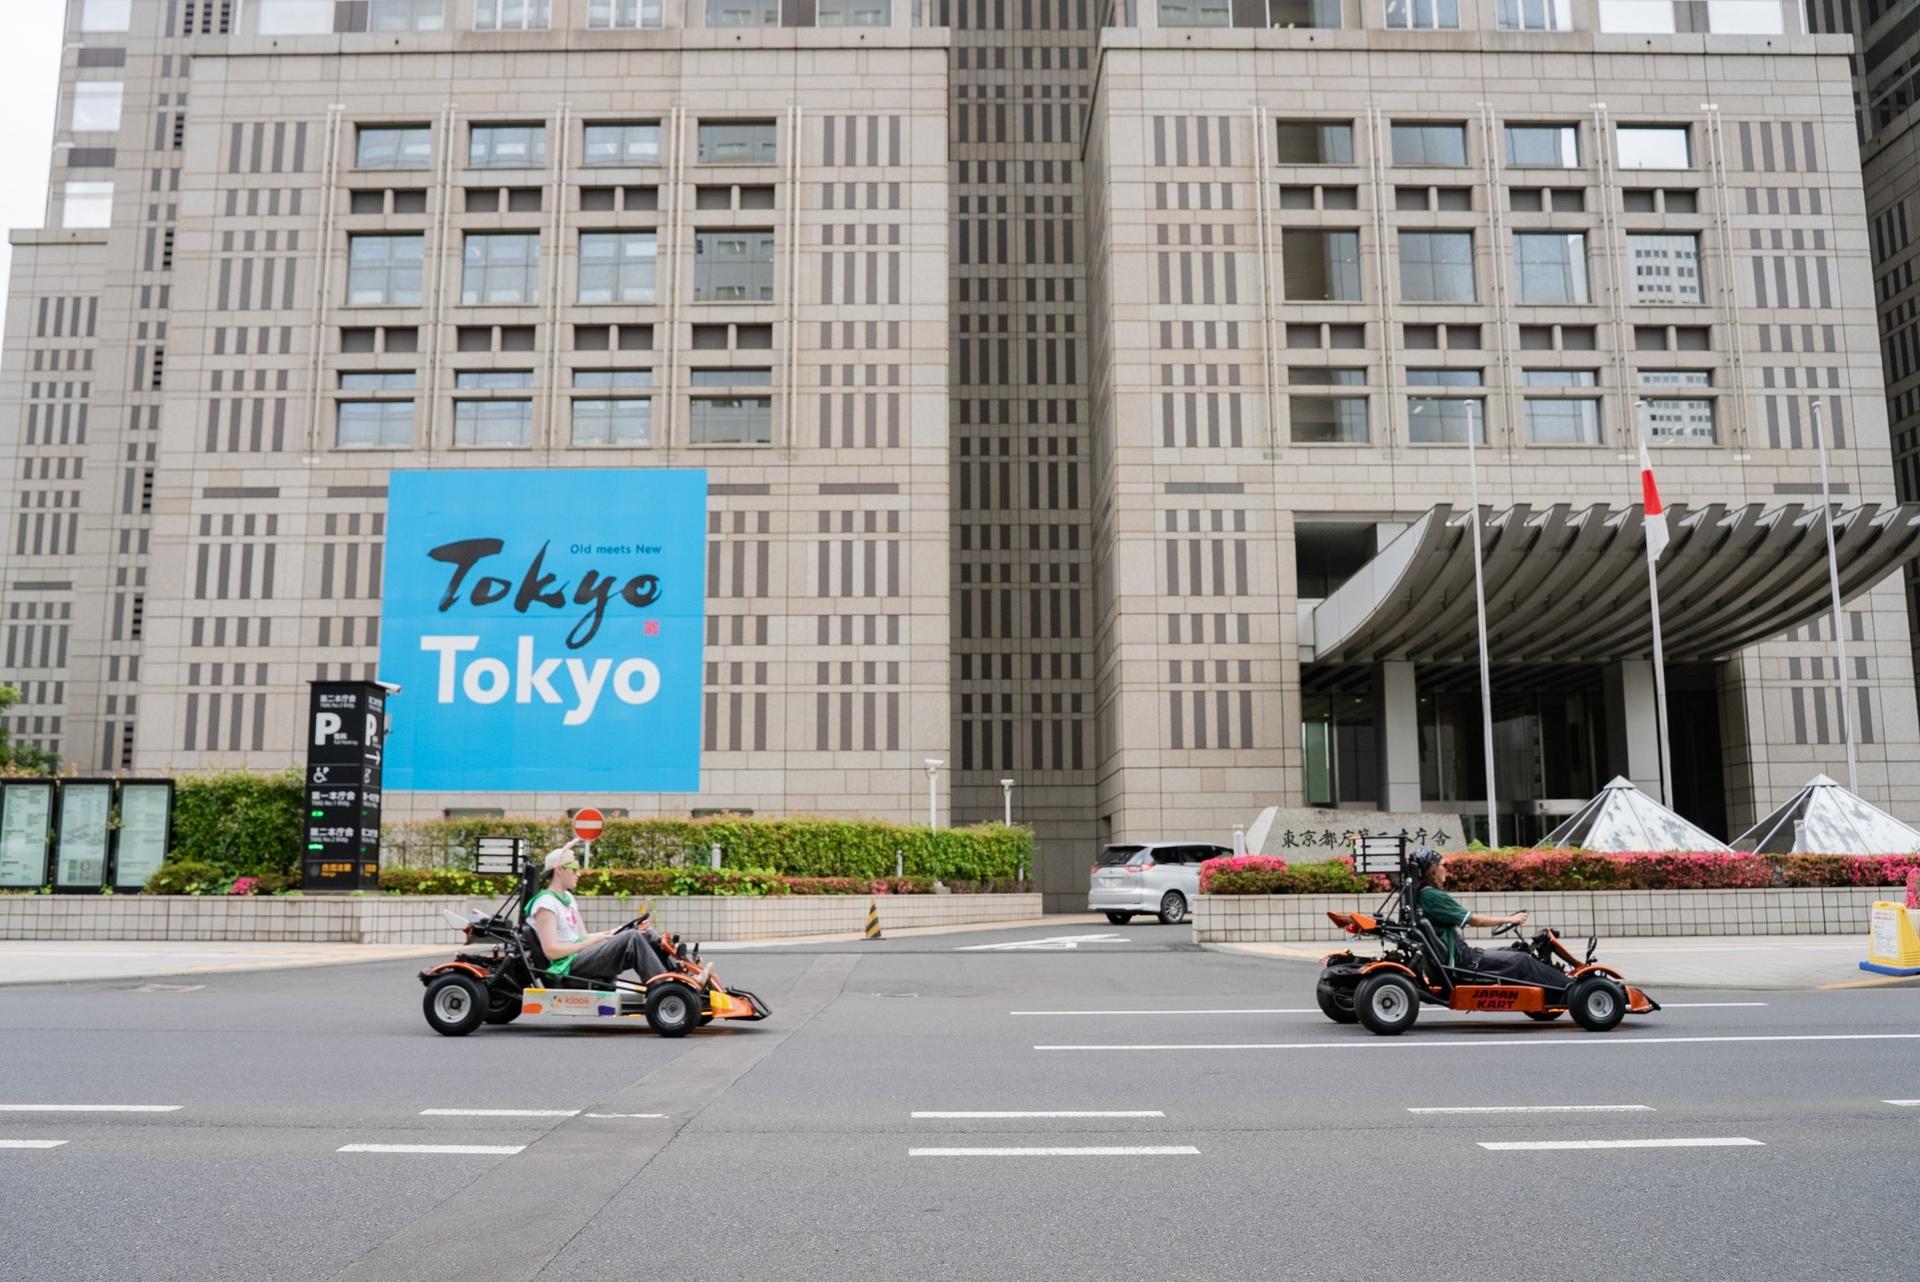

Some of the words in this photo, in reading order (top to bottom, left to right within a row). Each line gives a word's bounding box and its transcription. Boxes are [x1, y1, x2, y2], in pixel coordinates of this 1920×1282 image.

[570, 544, 592, 554] Old
[596, 544, 632, 554] meets
[635, 543, 662, 554] New
[427, 537, 663, 650] Tokyo
[420, 635, 661, 726] Tokyo
[314, 712, 342, 746] P
[365, 713, 378, 746] P
[1472, 990, 1519, 999] JAPAN
[1477, 1000, 1515, 1009] KART
